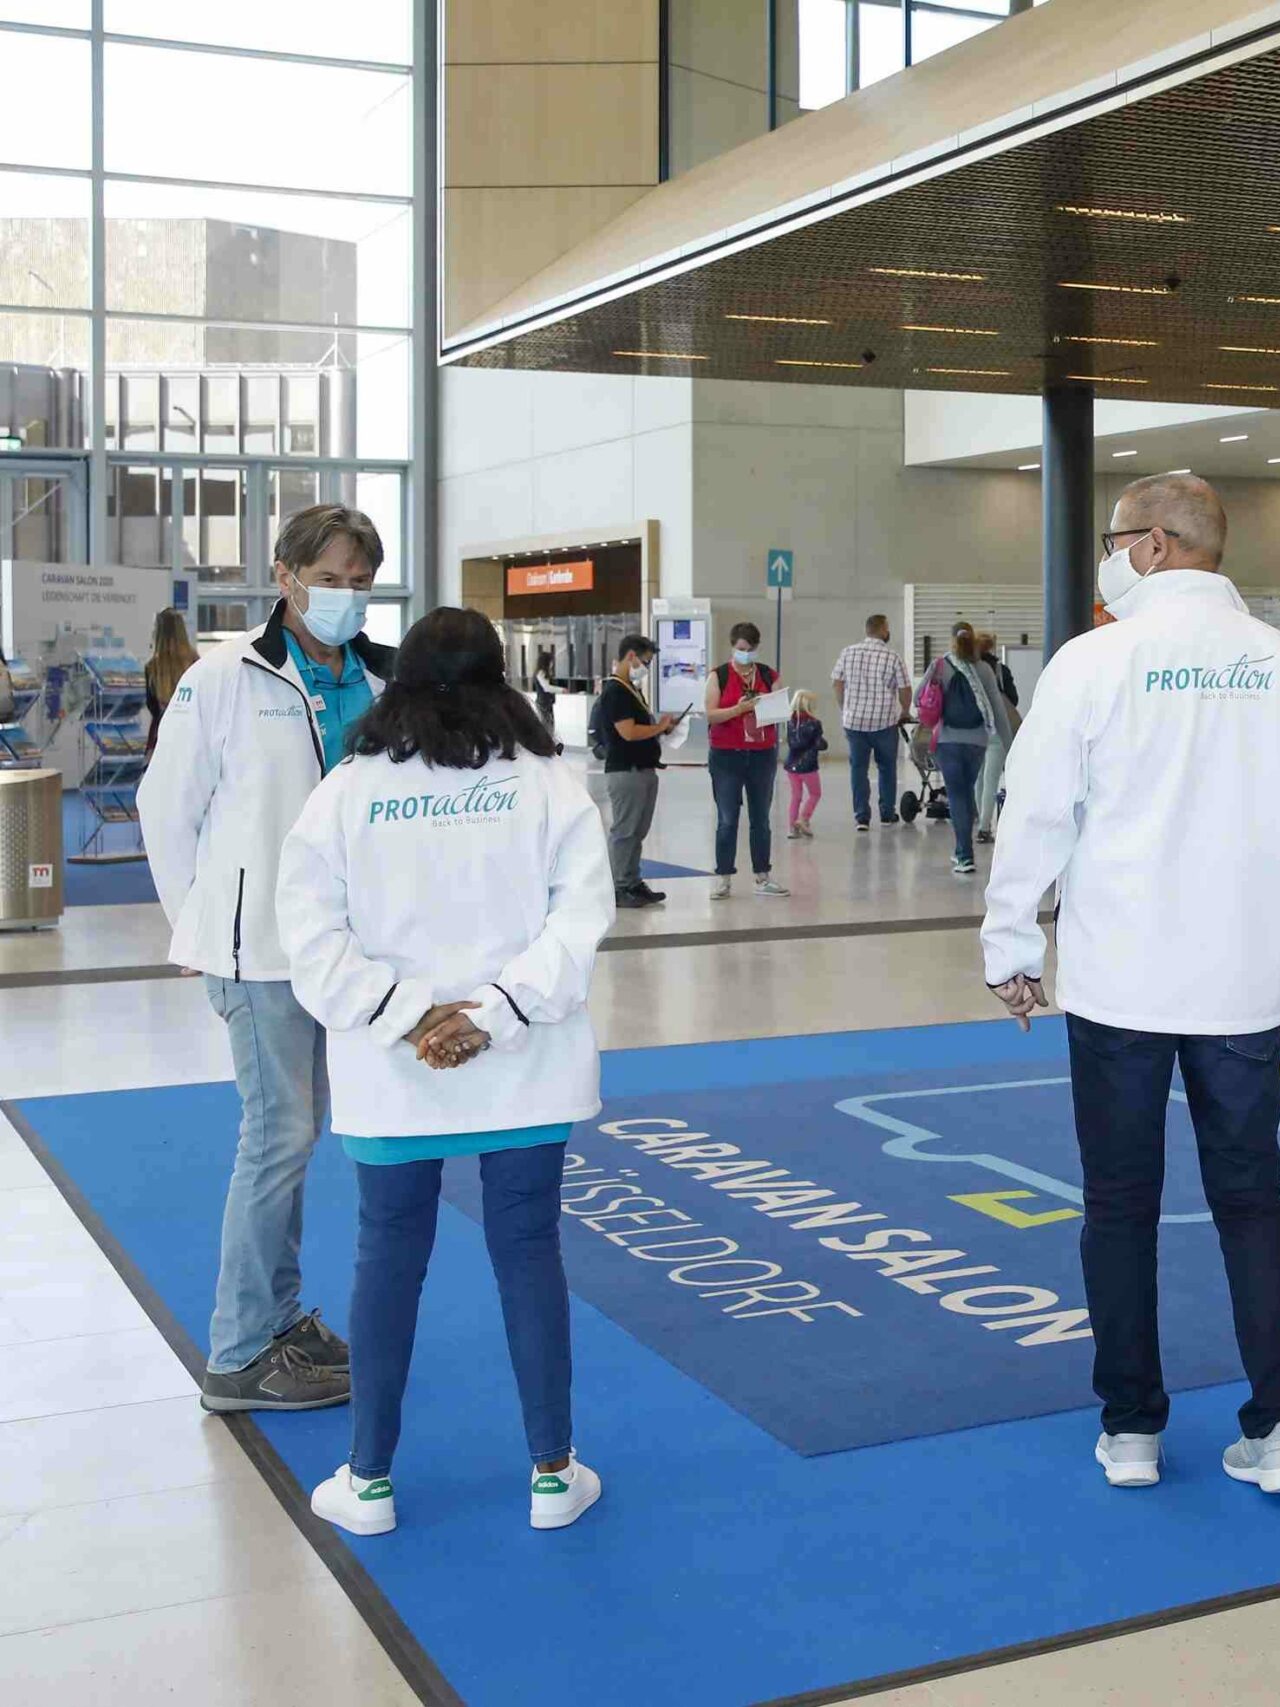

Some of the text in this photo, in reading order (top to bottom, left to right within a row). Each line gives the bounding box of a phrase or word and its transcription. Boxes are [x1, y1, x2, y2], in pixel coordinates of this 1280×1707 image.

[1146, 653, 1275, 692] PROTaction
[369, 775, 521, 824] PROTaction
[598, 1118, 1095, 1347] CARAVAN SALON
